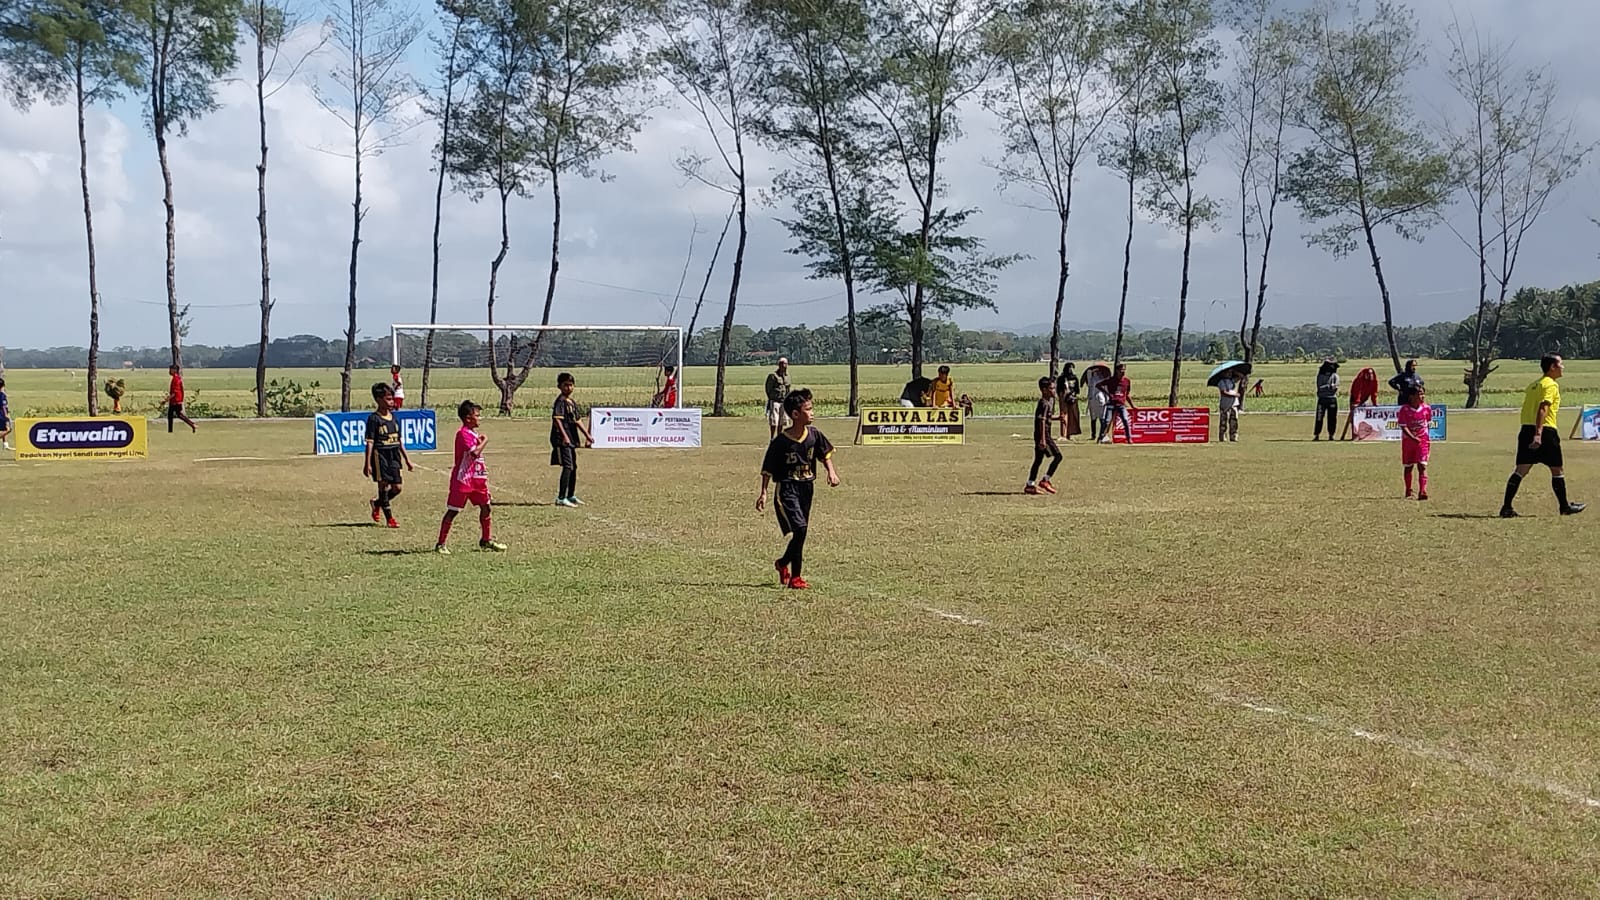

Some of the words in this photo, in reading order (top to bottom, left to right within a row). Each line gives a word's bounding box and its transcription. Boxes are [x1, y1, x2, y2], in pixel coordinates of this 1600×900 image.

[868, 411, 921, 422] GRIYA
[926, 411, 959, 422] LAS
[1137, 411, 1169, 422] SRC
[36, 426, 127, 442] Etawalin
[900, 425, 907, 433] &
